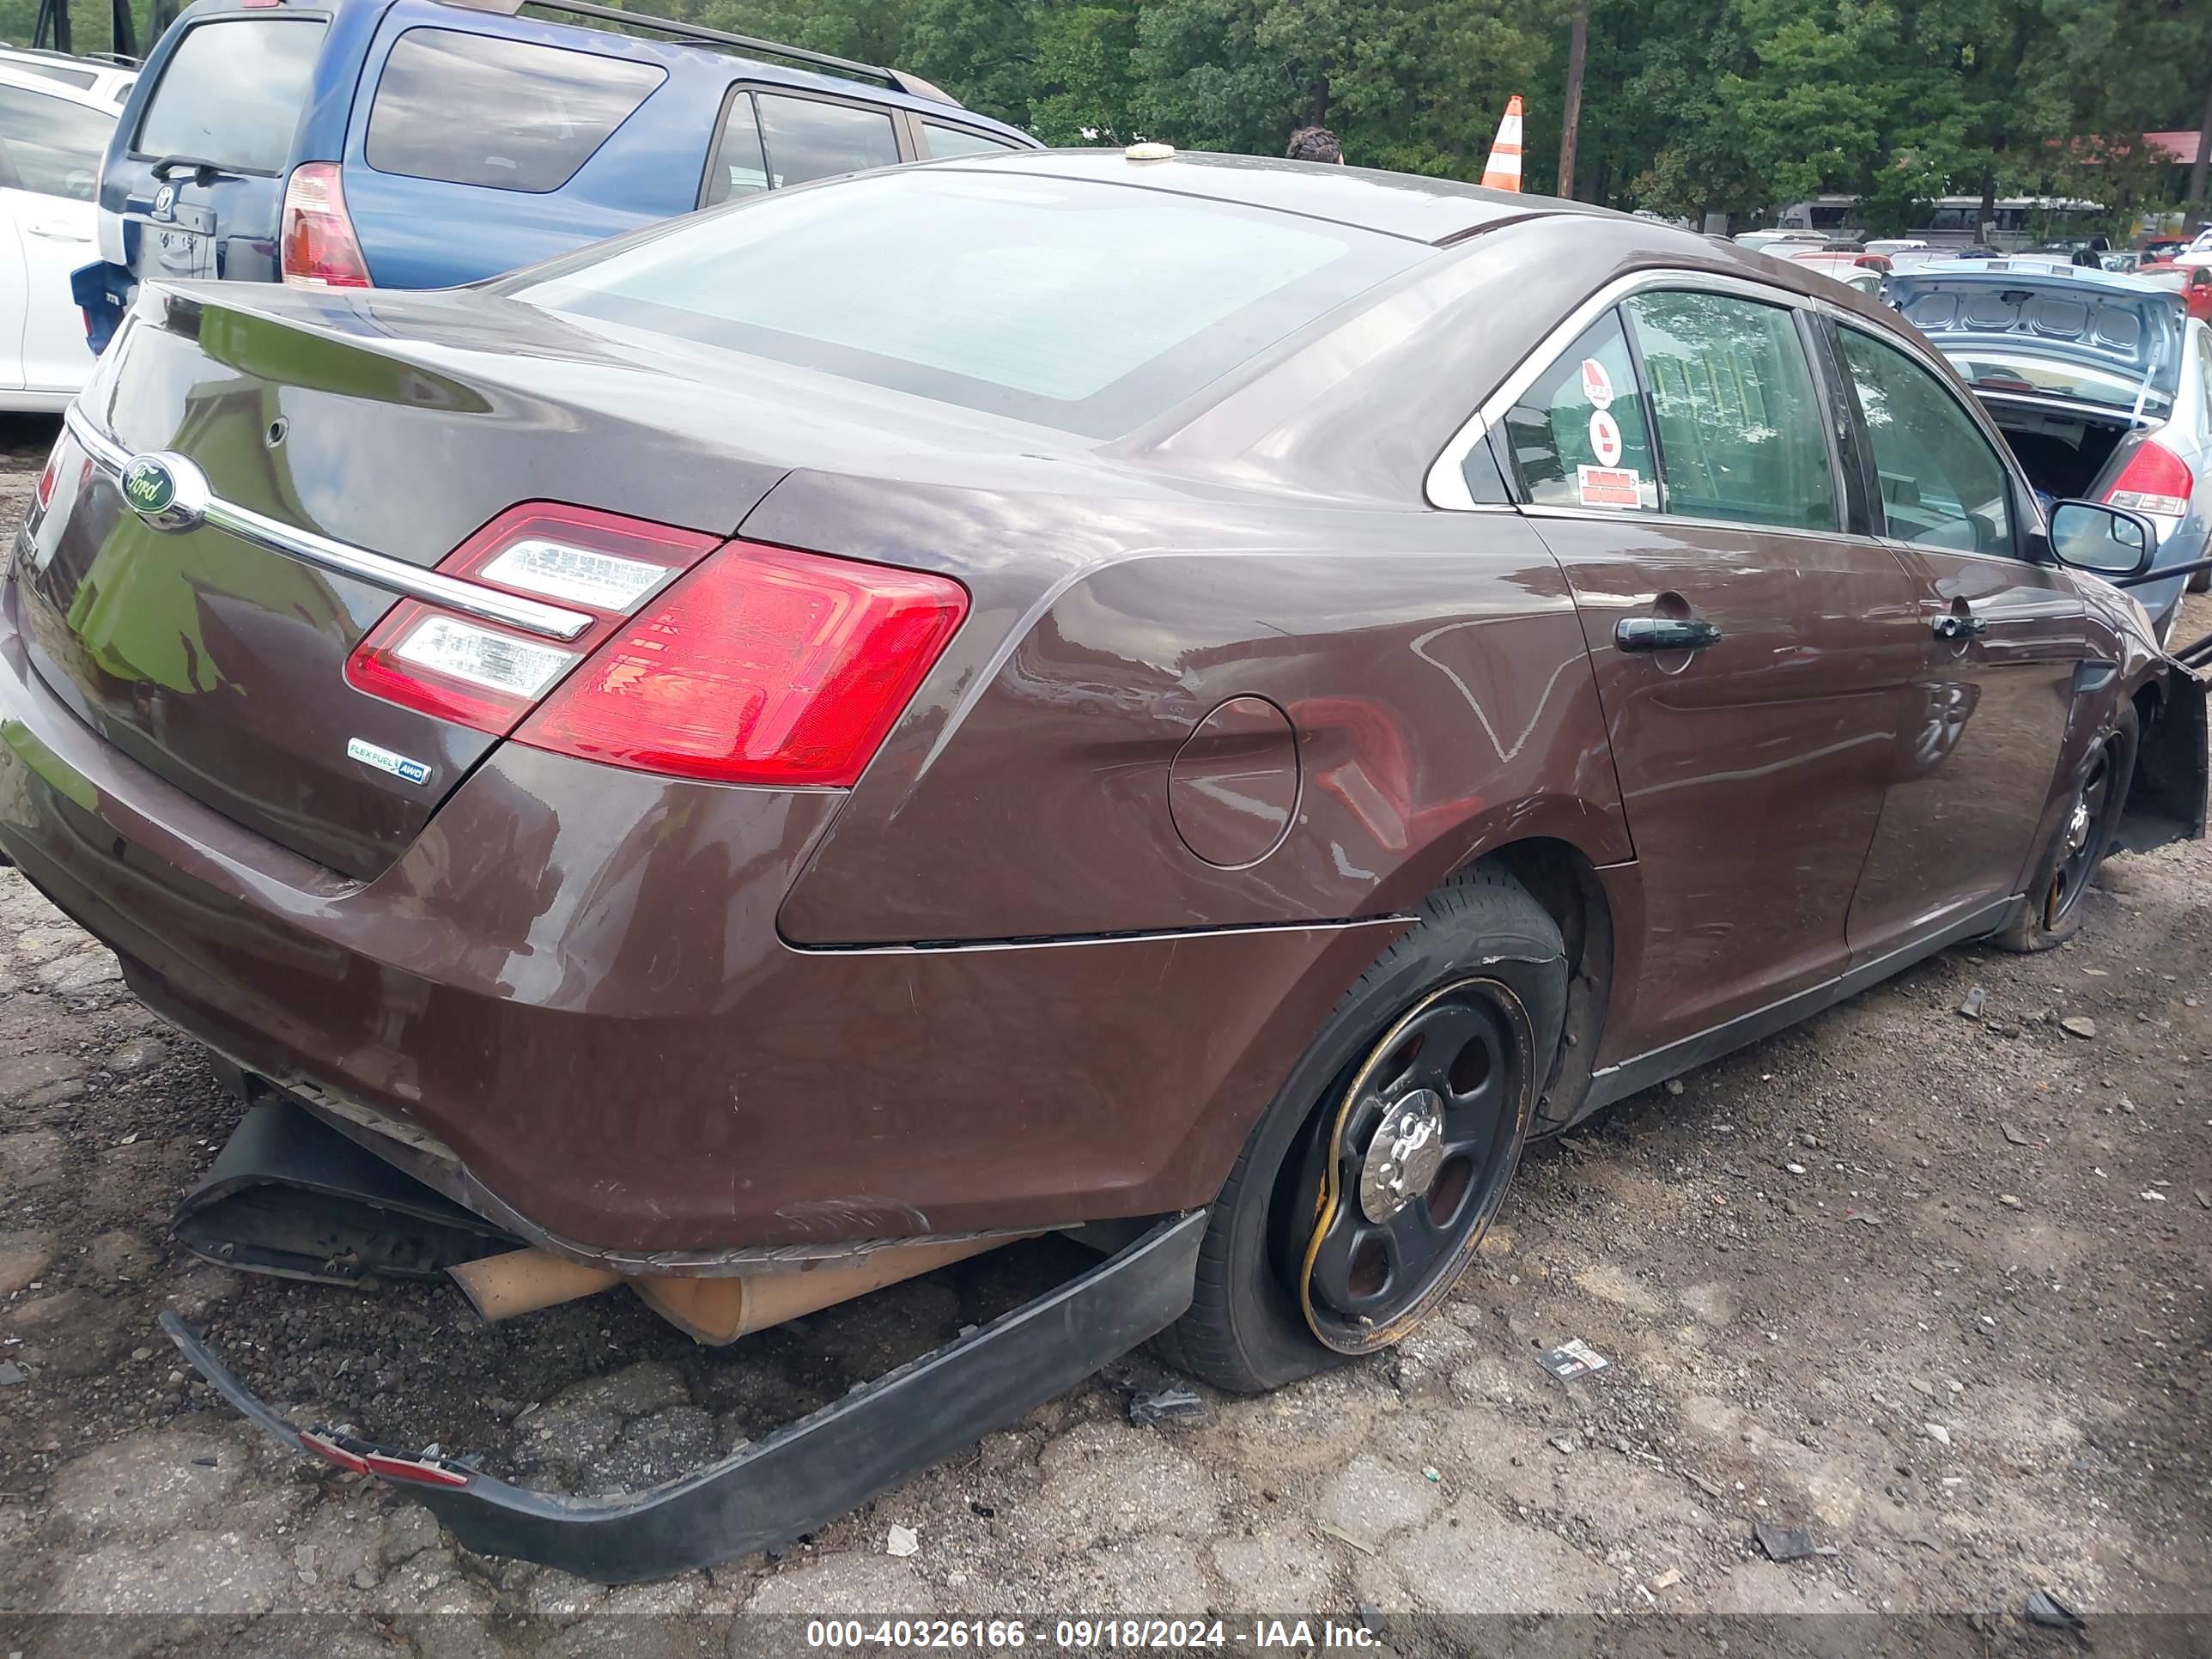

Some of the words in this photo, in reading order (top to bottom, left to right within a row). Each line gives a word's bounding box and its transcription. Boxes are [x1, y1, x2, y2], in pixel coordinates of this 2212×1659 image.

[126, 461, 164, 502] Ford
[350, 744, 372, 758] FLEX
[372, 753, 392, 767] FUEL
[399, 764, 422, 779] AWD
